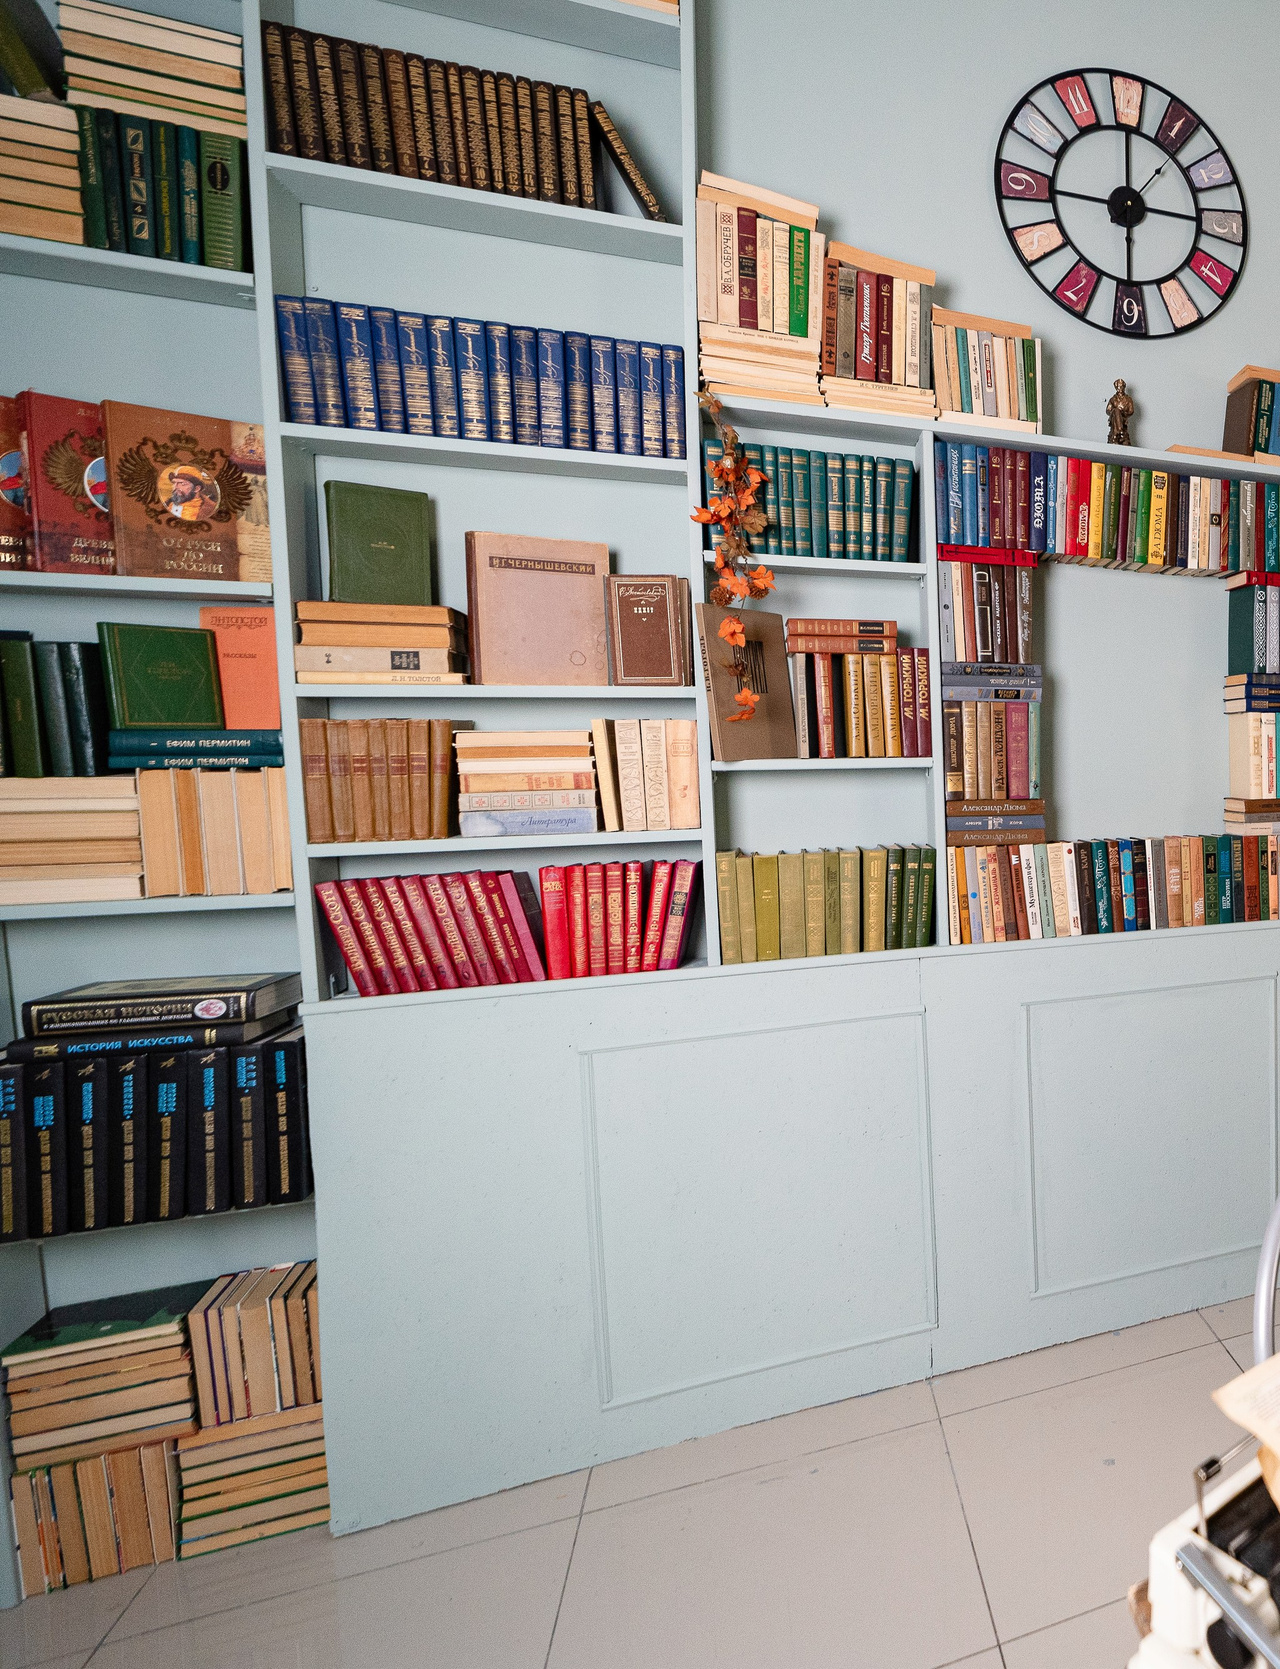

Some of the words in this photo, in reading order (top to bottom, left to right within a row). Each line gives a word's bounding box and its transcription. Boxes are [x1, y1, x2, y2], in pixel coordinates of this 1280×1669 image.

[1066, 84, 1091, 116] 11
[1026, 113, 1053, 145] 10
[1167, 116, 1186, 140] 1
[1007, 173, 1037, 195] 9
[722, 226, 732, 268] ОБРУЧЕВ
[793, 230, 805, 286] КАРНЕГИ
[1200, 260, 1224, 287] 4
[1064, 278, 1084, 302] 7
[1154, 507, 1163, 540] ДЮМА
[162, 537, 184, 548] ОТ
[186, 539, 222, 552] РУСИ
[164, 560, 224, 574] РОССИИ
[182, 551, 204, 562] ДО
[407, 675, 442, 683] ТОЛСТОЙ
[900, 655, 913, 703] ГОРЬКИЙ
[915, 656, 928, 704] ГОРЬКИЙ
[904, 705, 914, 720] М.
[919, 705, 929, 721] М.
[166, 740, 196, 748] ЕФИМ
[198, 739, 251, 748] ПЕРМИТИН
[994, 716, 1004, 758] ЛОНДОН
[164, 759, 194, 767] ЕФИМ
[196, 757, 249, 766] ПЕРМИТИН
[995, 759, 1005, 785] Джек
[962, 803, 1002, 814] Александр
[1003, 803, 1027, 812] Дюма
[521, 814, 577, 829] Литература
[963, 832, 1004, 842] Александр
[1004, 832, 1029, 840] Дюма
[1080, 849, 1089, 869] КАРР
[992, 867, 1000, 906] ЖЕРМИНАЛЬ
[41, 1007, 117, 1023] РУССКАЯ
[120, 1003, 194, 1018] ИСТОРИЯ
[67, 1040, 122, 1054] ИСТОРИЯ
[128, 1034, 194, 1048] ИСКУССТВА
